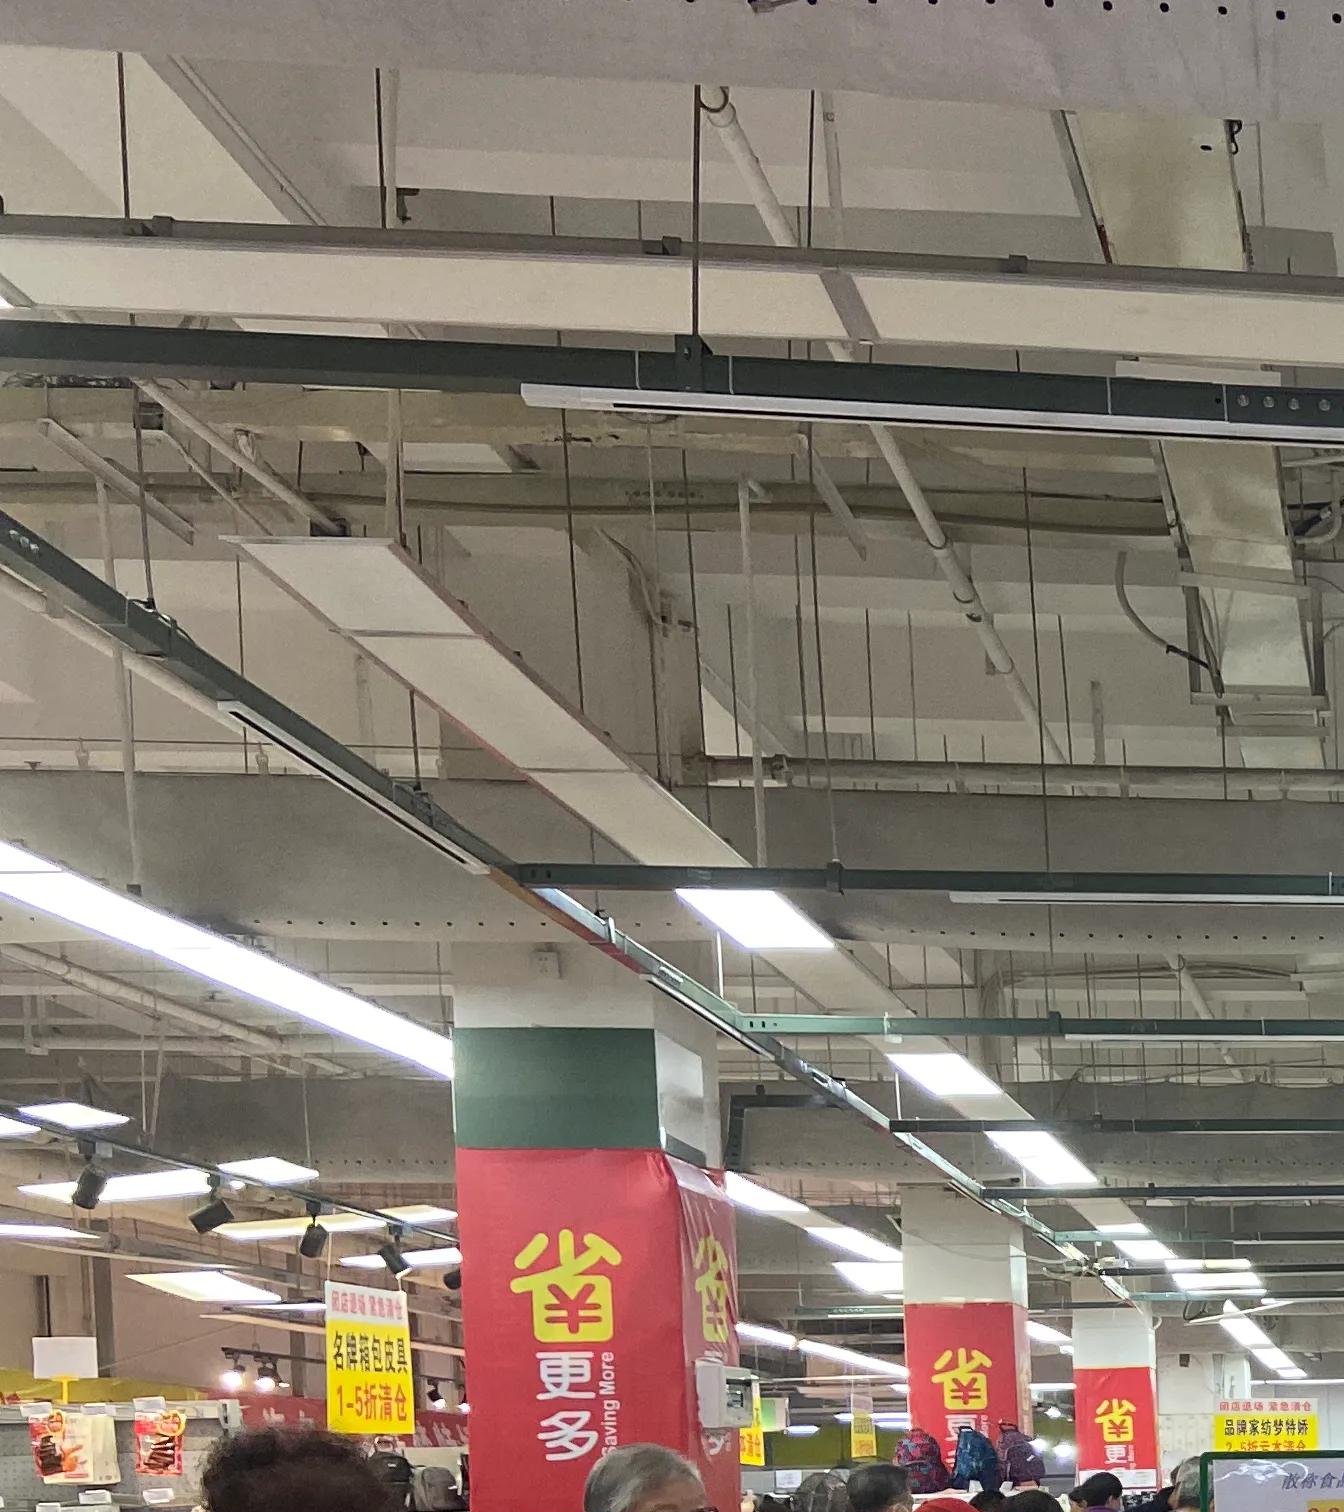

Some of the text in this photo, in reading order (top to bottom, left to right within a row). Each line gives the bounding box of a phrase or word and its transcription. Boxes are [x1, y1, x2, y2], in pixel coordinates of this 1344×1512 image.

[333, 1330, 408, 1374] 名牌箱包皮具
[599, 1351, 616, 1395] More
[337, 1383, 408, 1422] 1-5折清仓
[1224, 1419, 1309, 1437] 品牌家纺梦特娇
